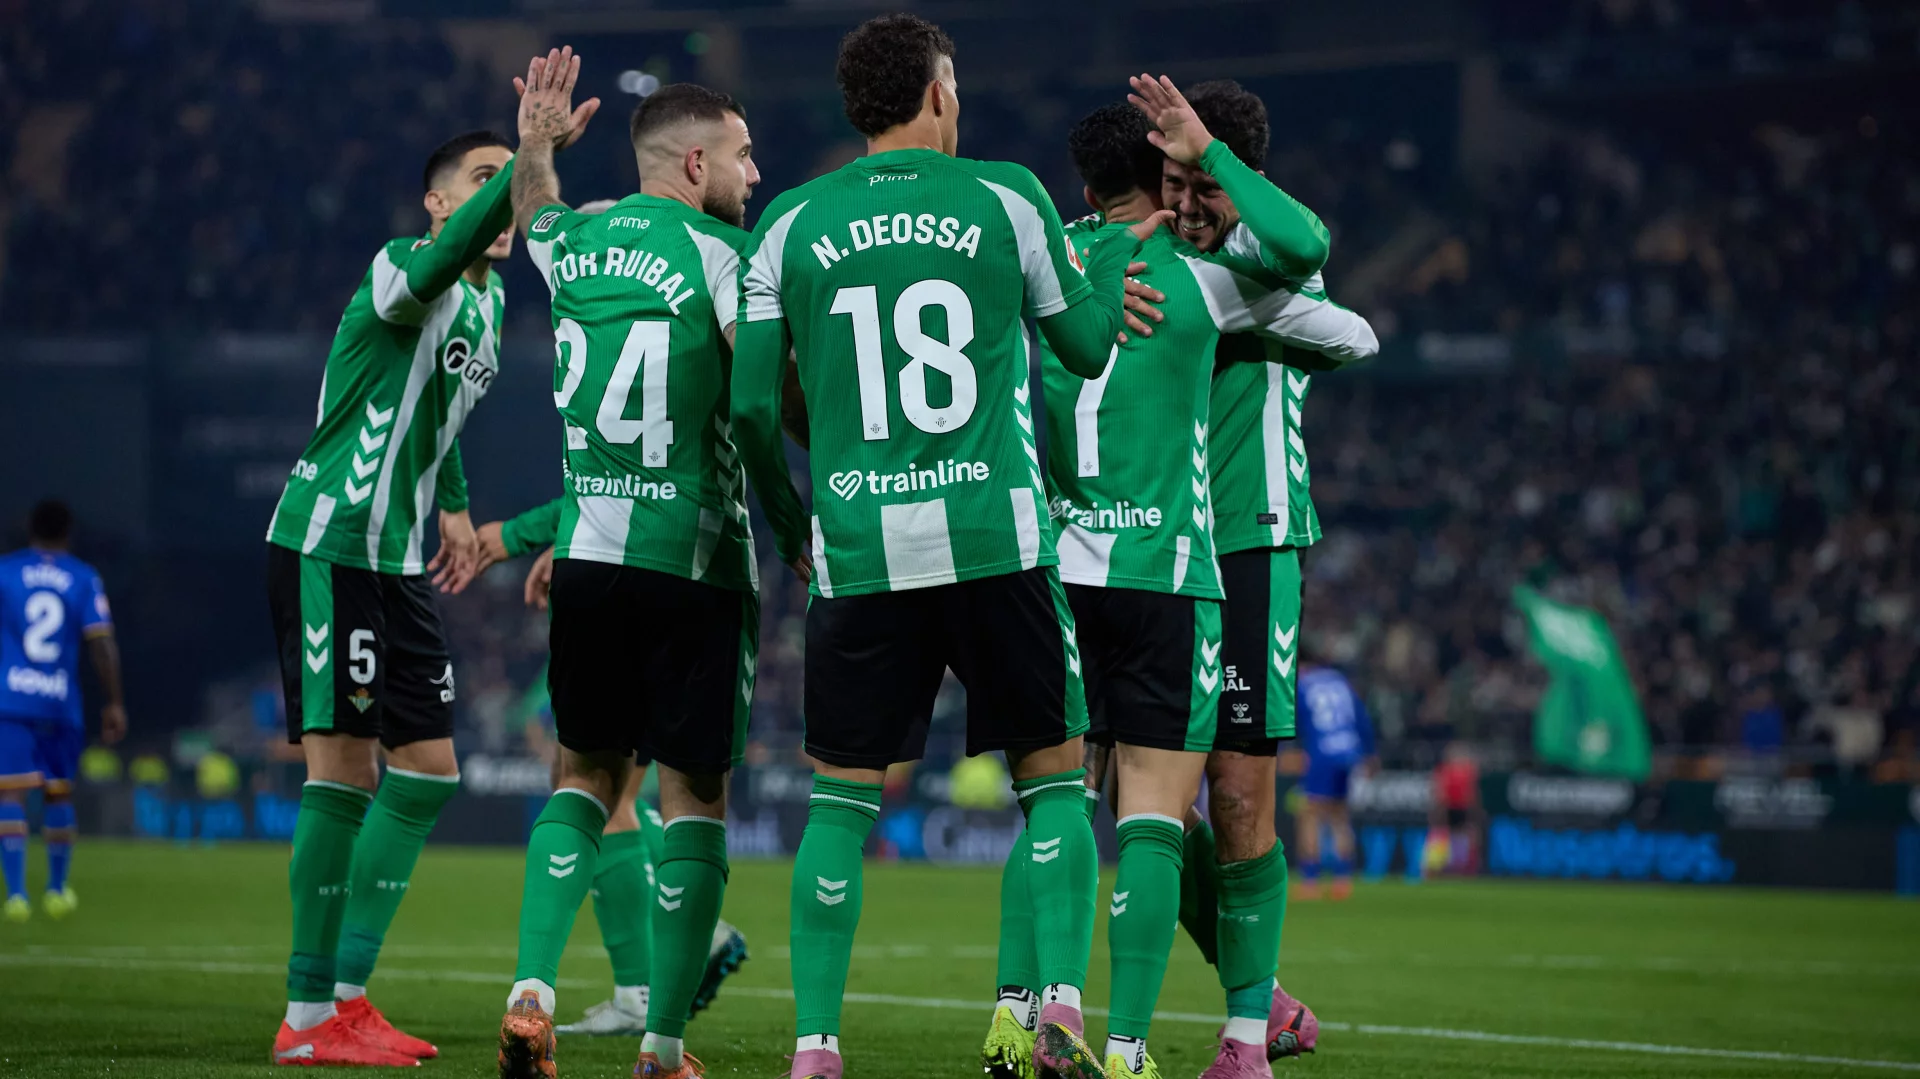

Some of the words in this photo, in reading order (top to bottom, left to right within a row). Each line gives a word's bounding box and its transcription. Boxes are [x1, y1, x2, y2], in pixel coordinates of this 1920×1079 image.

[869, 172, 917, 186] prima
[608, 216, 651, 230] prima
[849, 213, 982, 259] DEOSSA
[603, 247, 695, 316] RUIBAL
[828, 278, 978, 441] 18
[553, 318, 674, 468] 24
[574, 470, 677, 500] trainline
[866, 458, 990, 494] trainline
[1060, 499, 1162, 529] trainline
[24, 590, 65, 664] 2
[348, 629, 376, 685] 5
